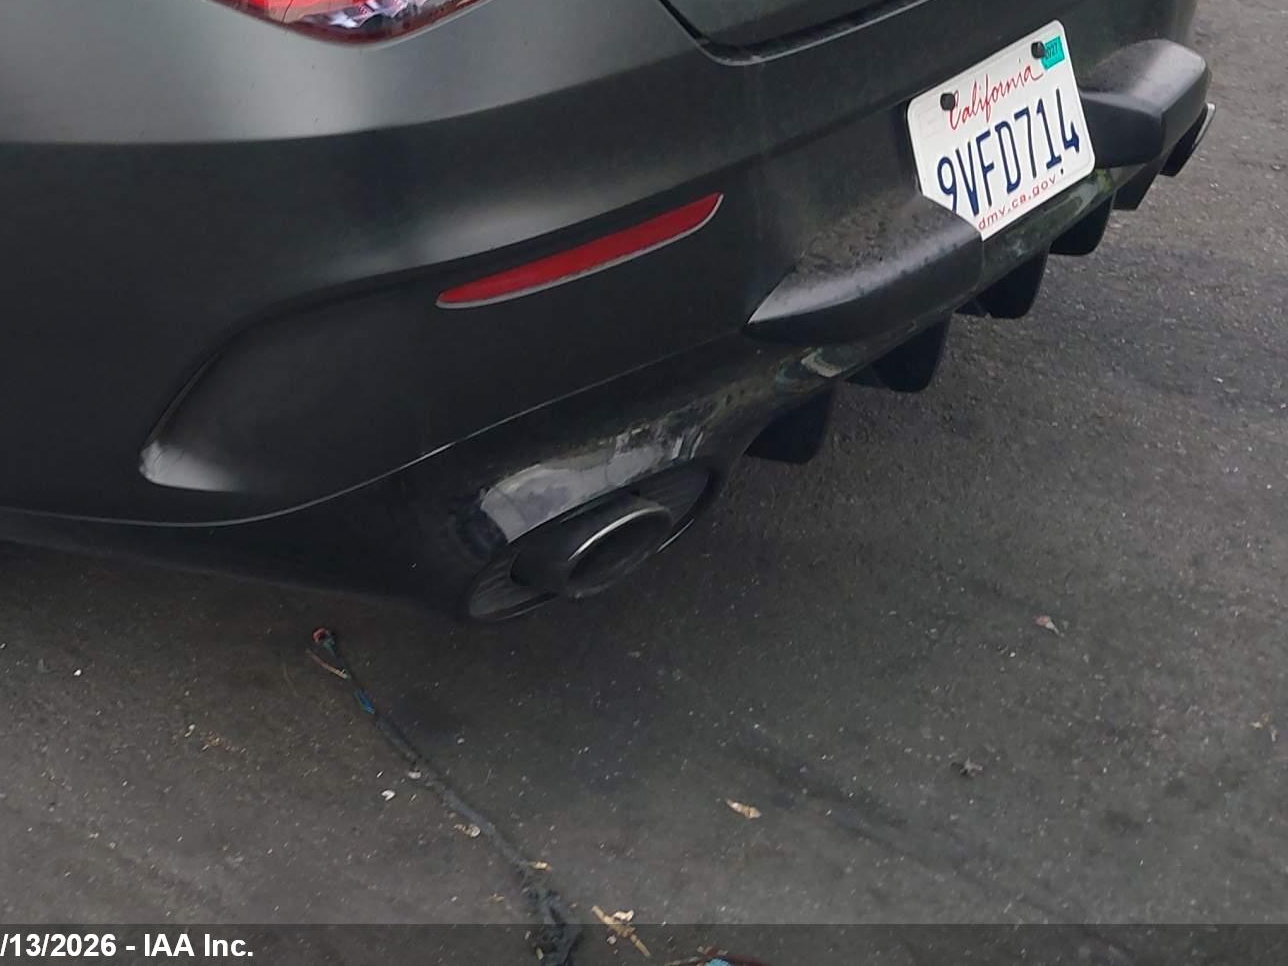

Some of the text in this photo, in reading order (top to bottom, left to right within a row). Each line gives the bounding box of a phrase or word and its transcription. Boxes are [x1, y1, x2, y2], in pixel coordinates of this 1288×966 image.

[947, 58, 1044, 130] California
[936, 88, 1080, 217] 9VFD714
[978, 174, 1058, 231] dmv.ca.gov
